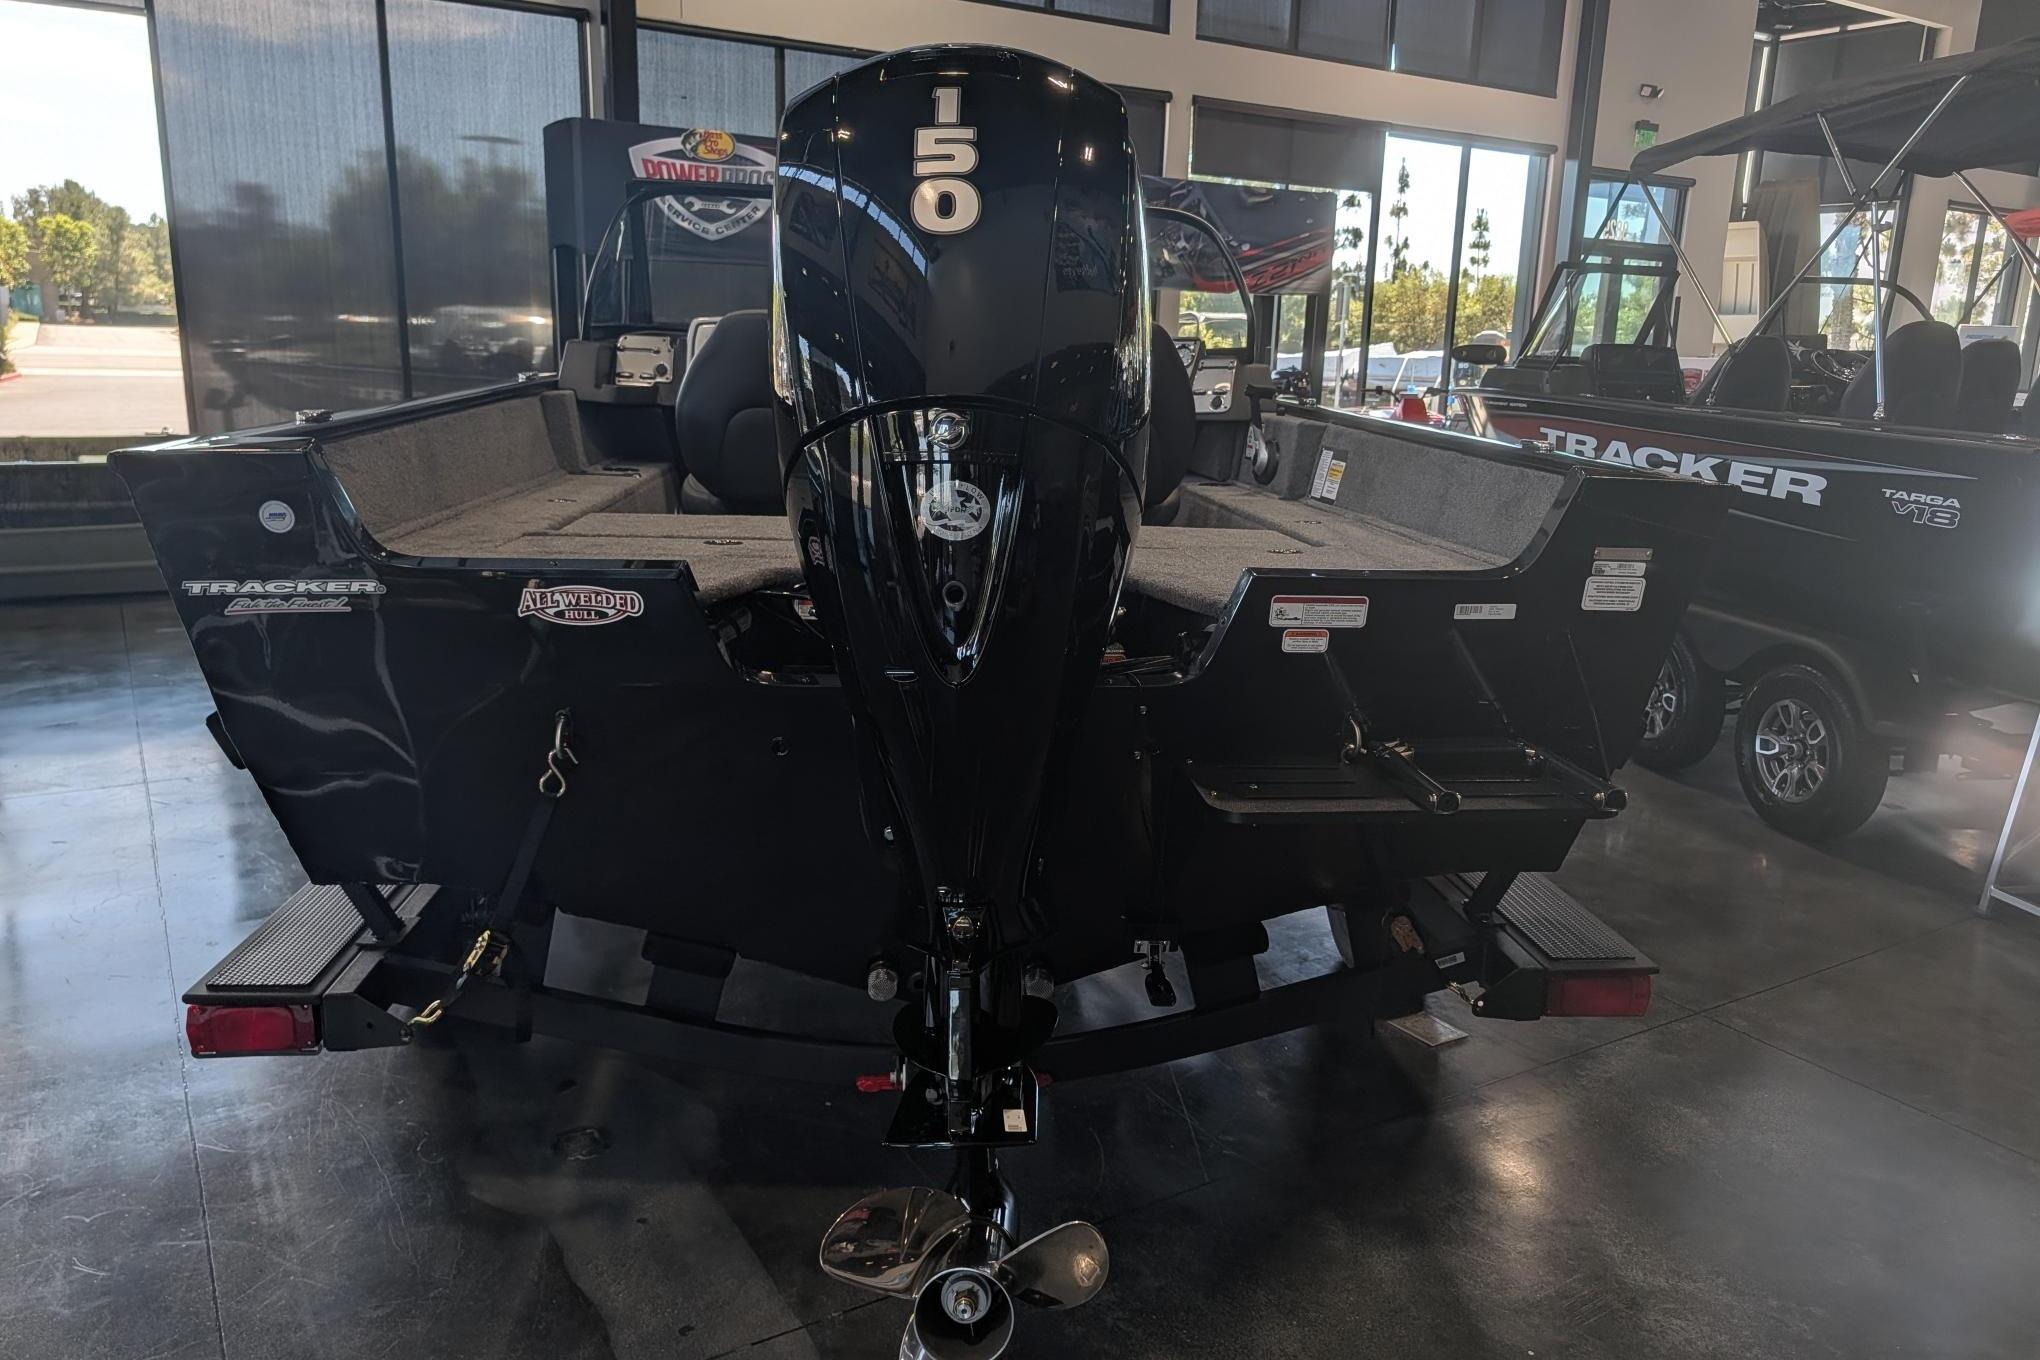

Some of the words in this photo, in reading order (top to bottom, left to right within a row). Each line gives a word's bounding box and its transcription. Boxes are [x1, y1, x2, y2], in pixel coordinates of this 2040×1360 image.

[911, 87, 982, 235] 150
[715, 206, 761, 235] CENTER
[1539, 426, 1828, 506] TRACKER
[1881, 488, 1961, 509] TARGA
[1891, 500, 1961, 529] V18
[182, 580, 380, 596] TRACKER
[521, 592, 559, 612] ALL
[560, 592, 640, 613] WELDED
[564, 610, 600, 620] HULL
